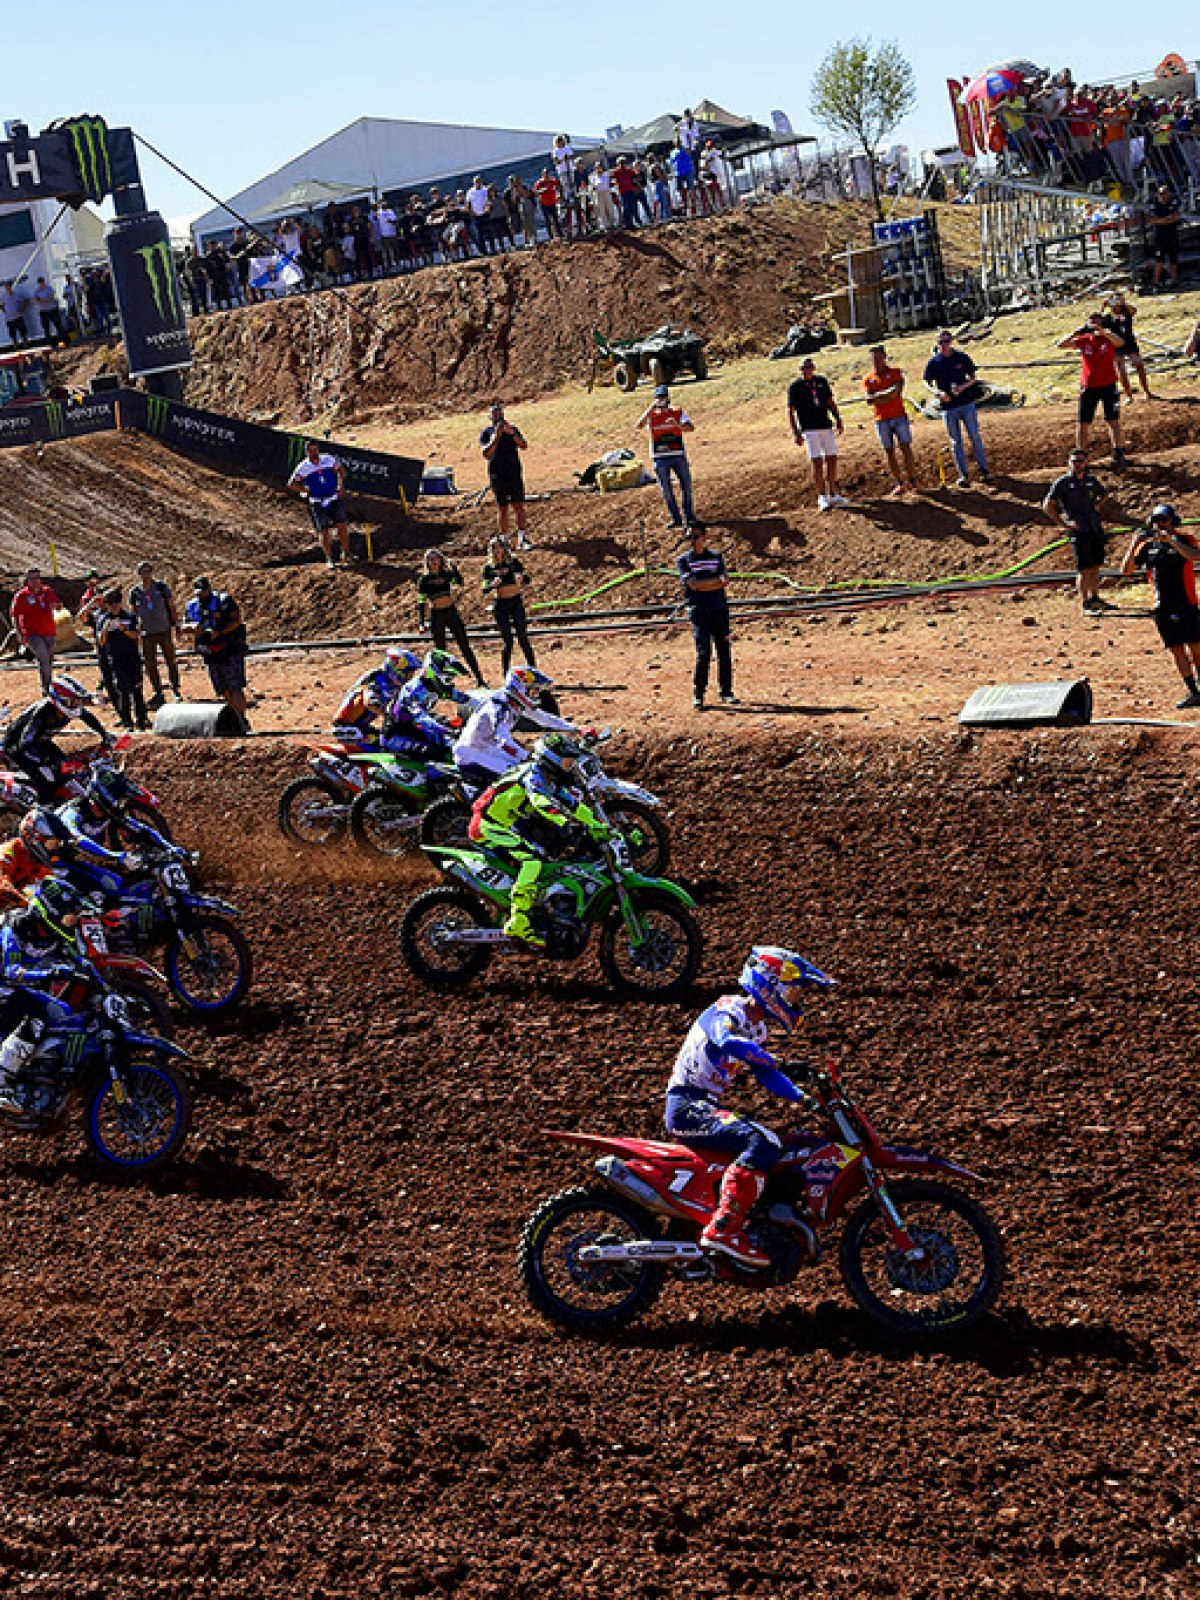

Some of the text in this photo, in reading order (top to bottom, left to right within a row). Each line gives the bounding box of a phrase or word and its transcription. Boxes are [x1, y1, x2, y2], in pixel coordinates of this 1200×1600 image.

[171, 413, 237, 443] MONSTER
[340, 454, 390, 478] NSTER
[667, 1169, 695, 1192] 1
